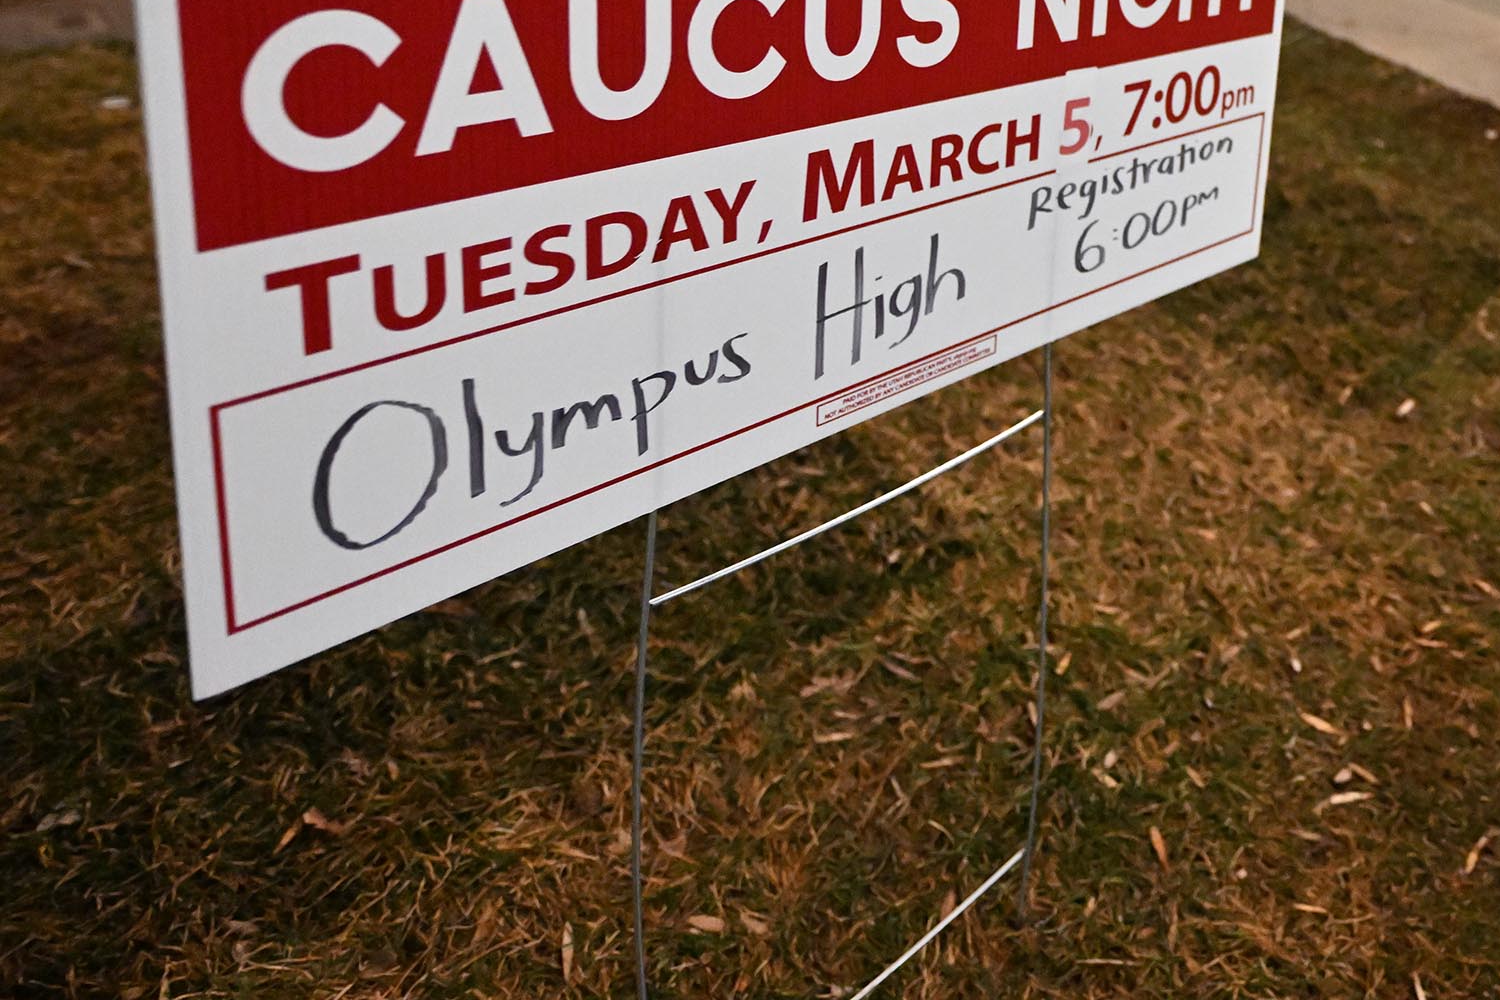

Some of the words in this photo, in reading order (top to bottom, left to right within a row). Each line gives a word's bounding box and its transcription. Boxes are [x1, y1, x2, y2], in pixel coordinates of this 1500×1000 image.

[264, 178, 774, 356] TUESDAY,
[802, 114, 1042, 223] MARCH
[1123, 64, 1255, 119] 7:00pm
[1027, 137, 1234, 231] Registration
[312, 332, 753, 550] Olympus
[815, 233, 965, 380] High
